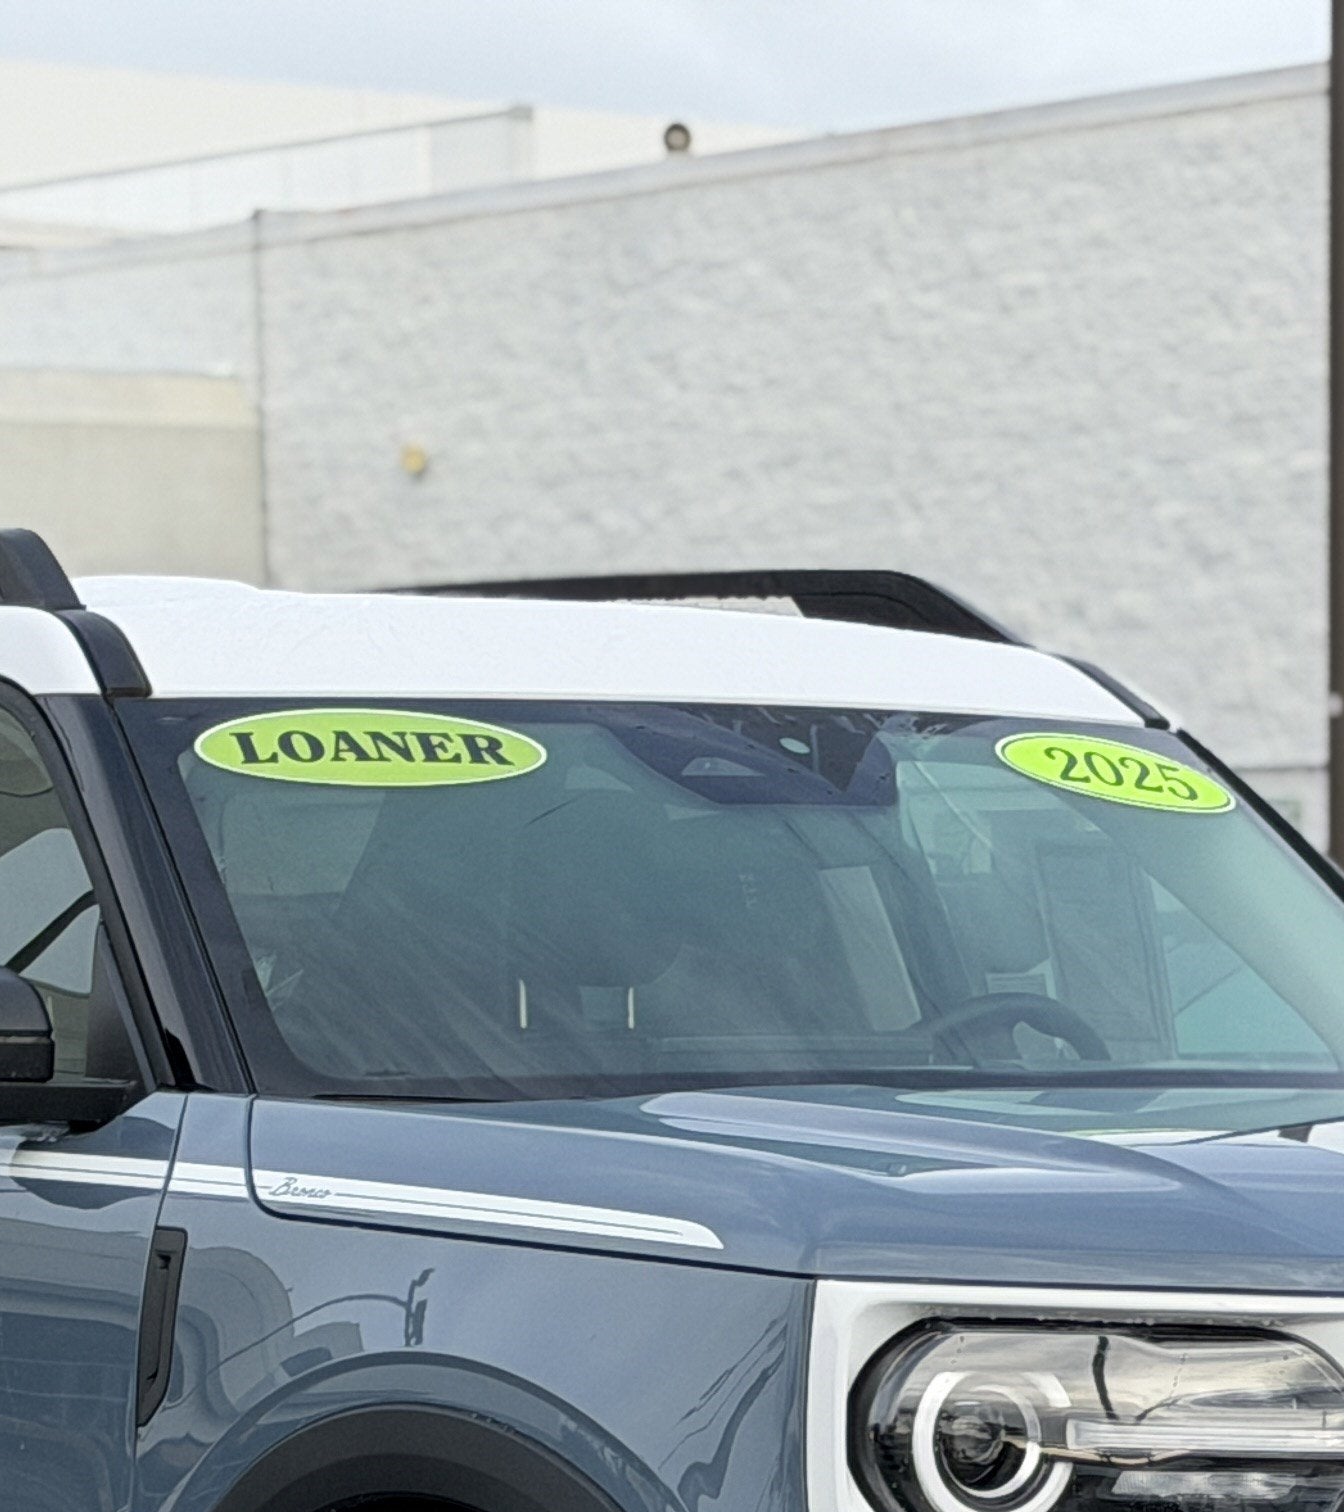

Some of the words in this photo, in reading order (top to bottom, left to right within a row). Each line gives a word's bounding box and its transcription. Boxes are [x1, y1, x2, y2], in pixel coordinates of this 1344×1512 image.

[229, 729, 516, 767] LOANER
[1043, 746, 1199, 801] 2025
[268, 1176, 332, 1199] Bronco
